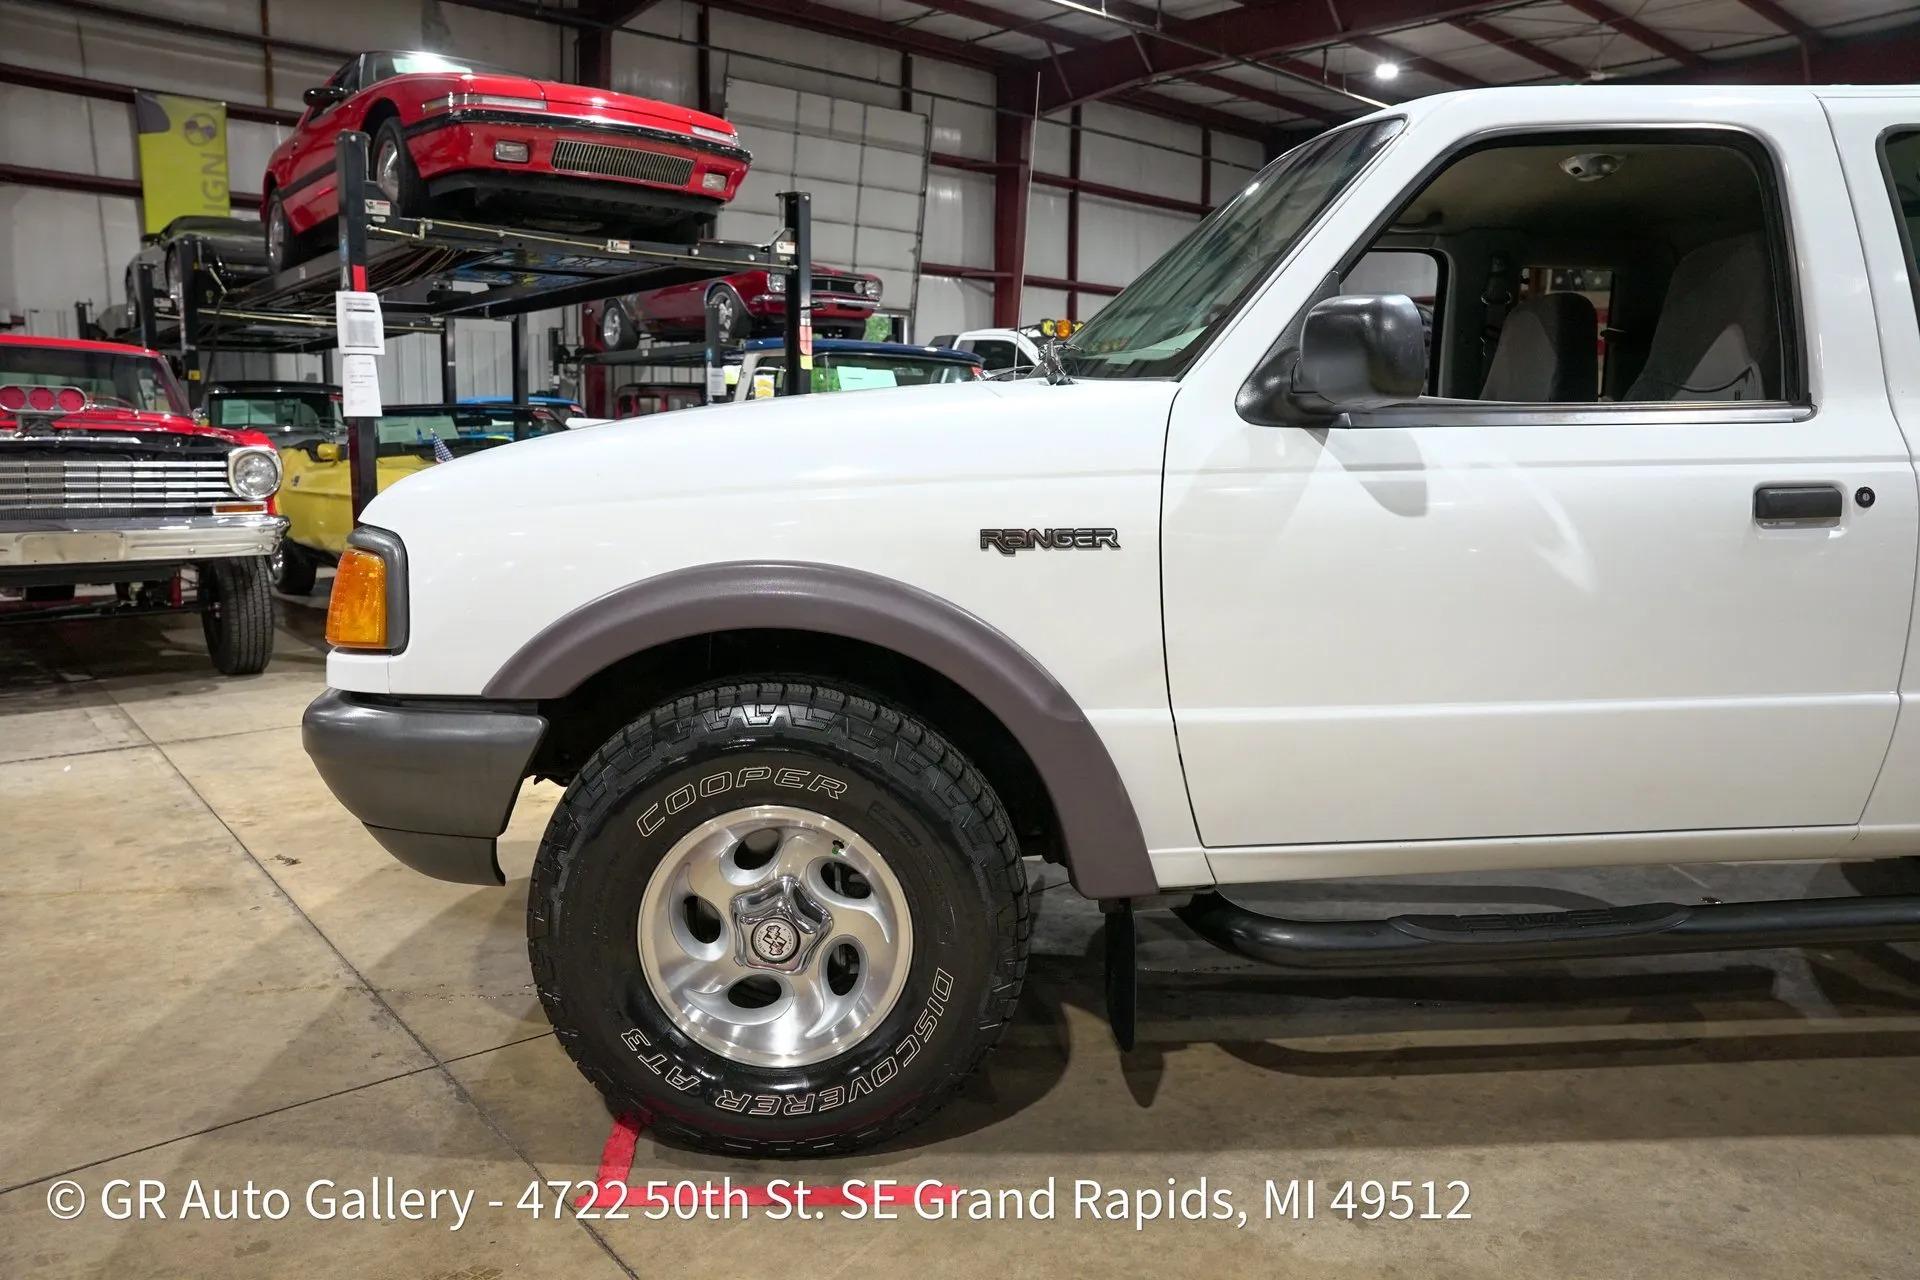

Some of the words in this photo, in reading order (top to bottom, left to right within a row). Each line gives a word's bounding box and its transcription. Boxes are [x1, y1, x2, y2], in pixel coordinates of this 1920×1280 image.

[979, 528, 1121, 555] RANGER
[636, 766, 848, 838] COOPER
[620, 1027, 703, 1092] AT3
[714, 966, 955, 1117] DISCOVERER
